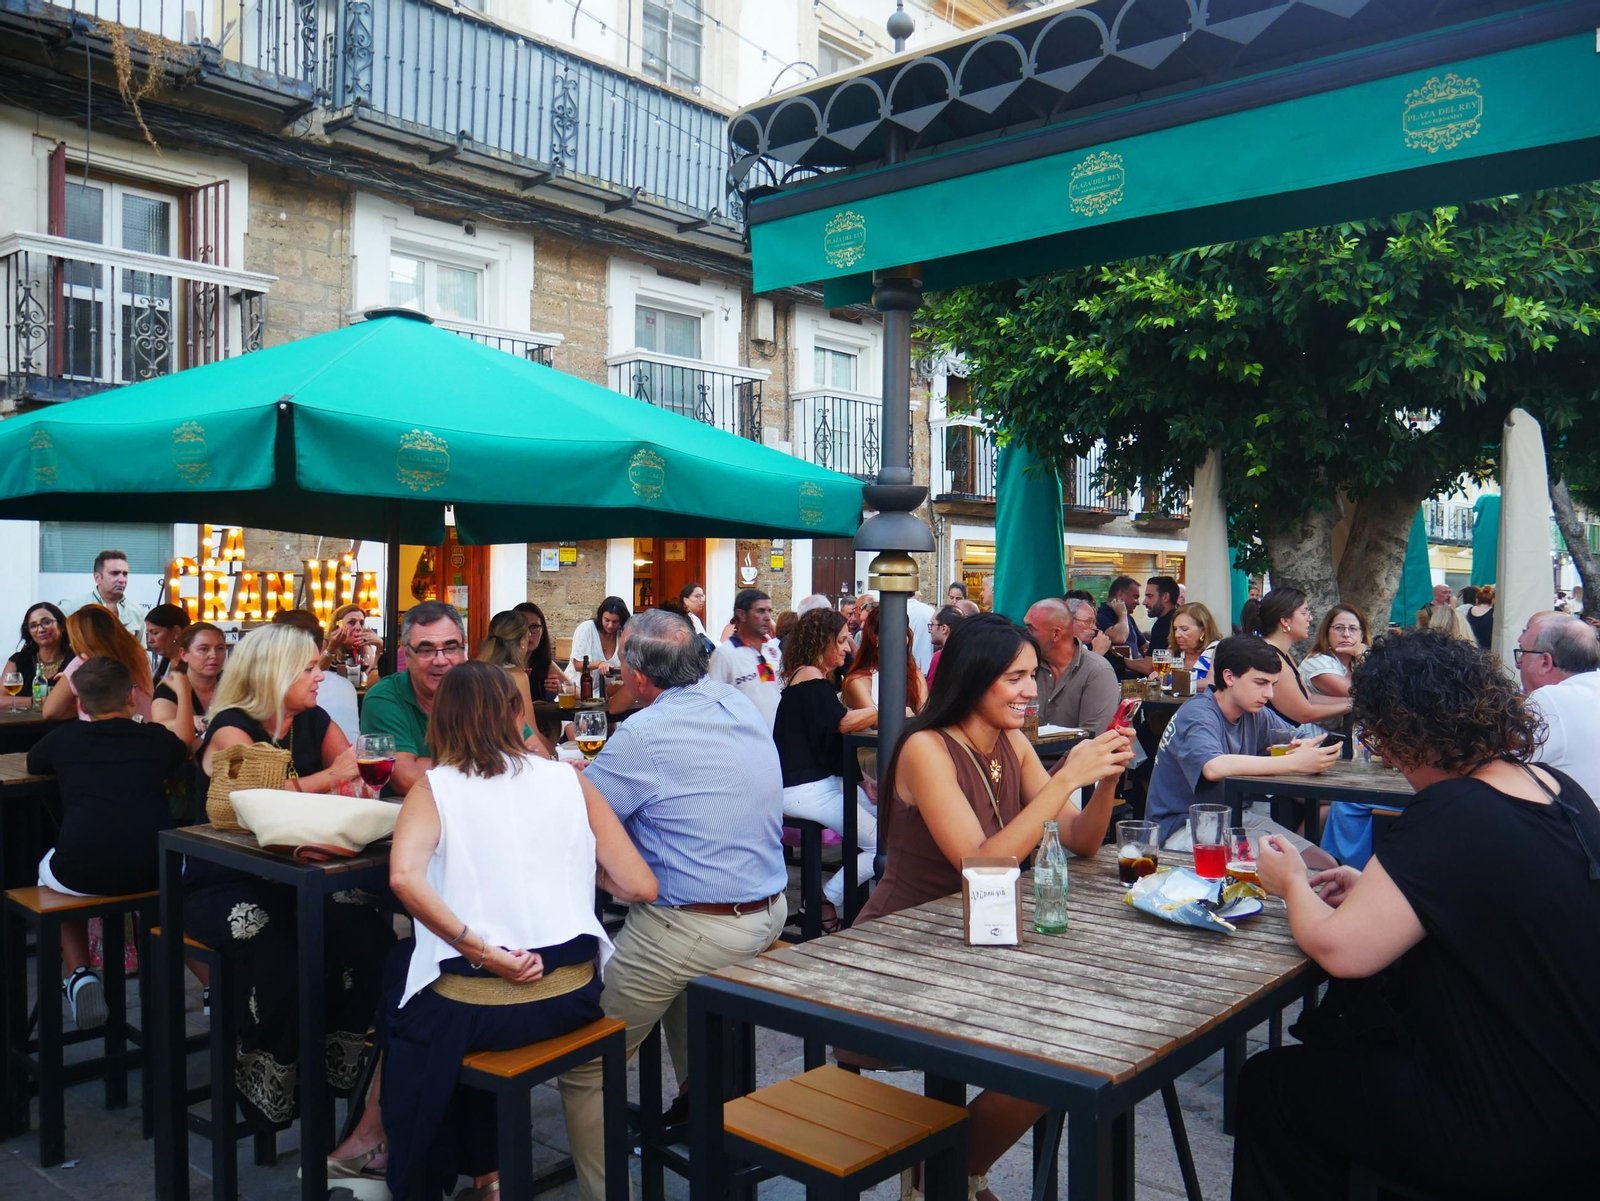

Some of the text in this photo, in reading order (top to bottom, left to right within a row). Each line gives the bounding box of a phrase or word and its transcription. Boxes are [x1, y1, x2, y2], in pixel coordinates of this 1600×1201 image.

[1407, 100, 1478, 122] PLAZA DEL REY
[1072, 173, 1121, 191] PLAZA DEL REY
[198, 523, 247, 567] LA
[165, 556, 295, 626] GRAN
